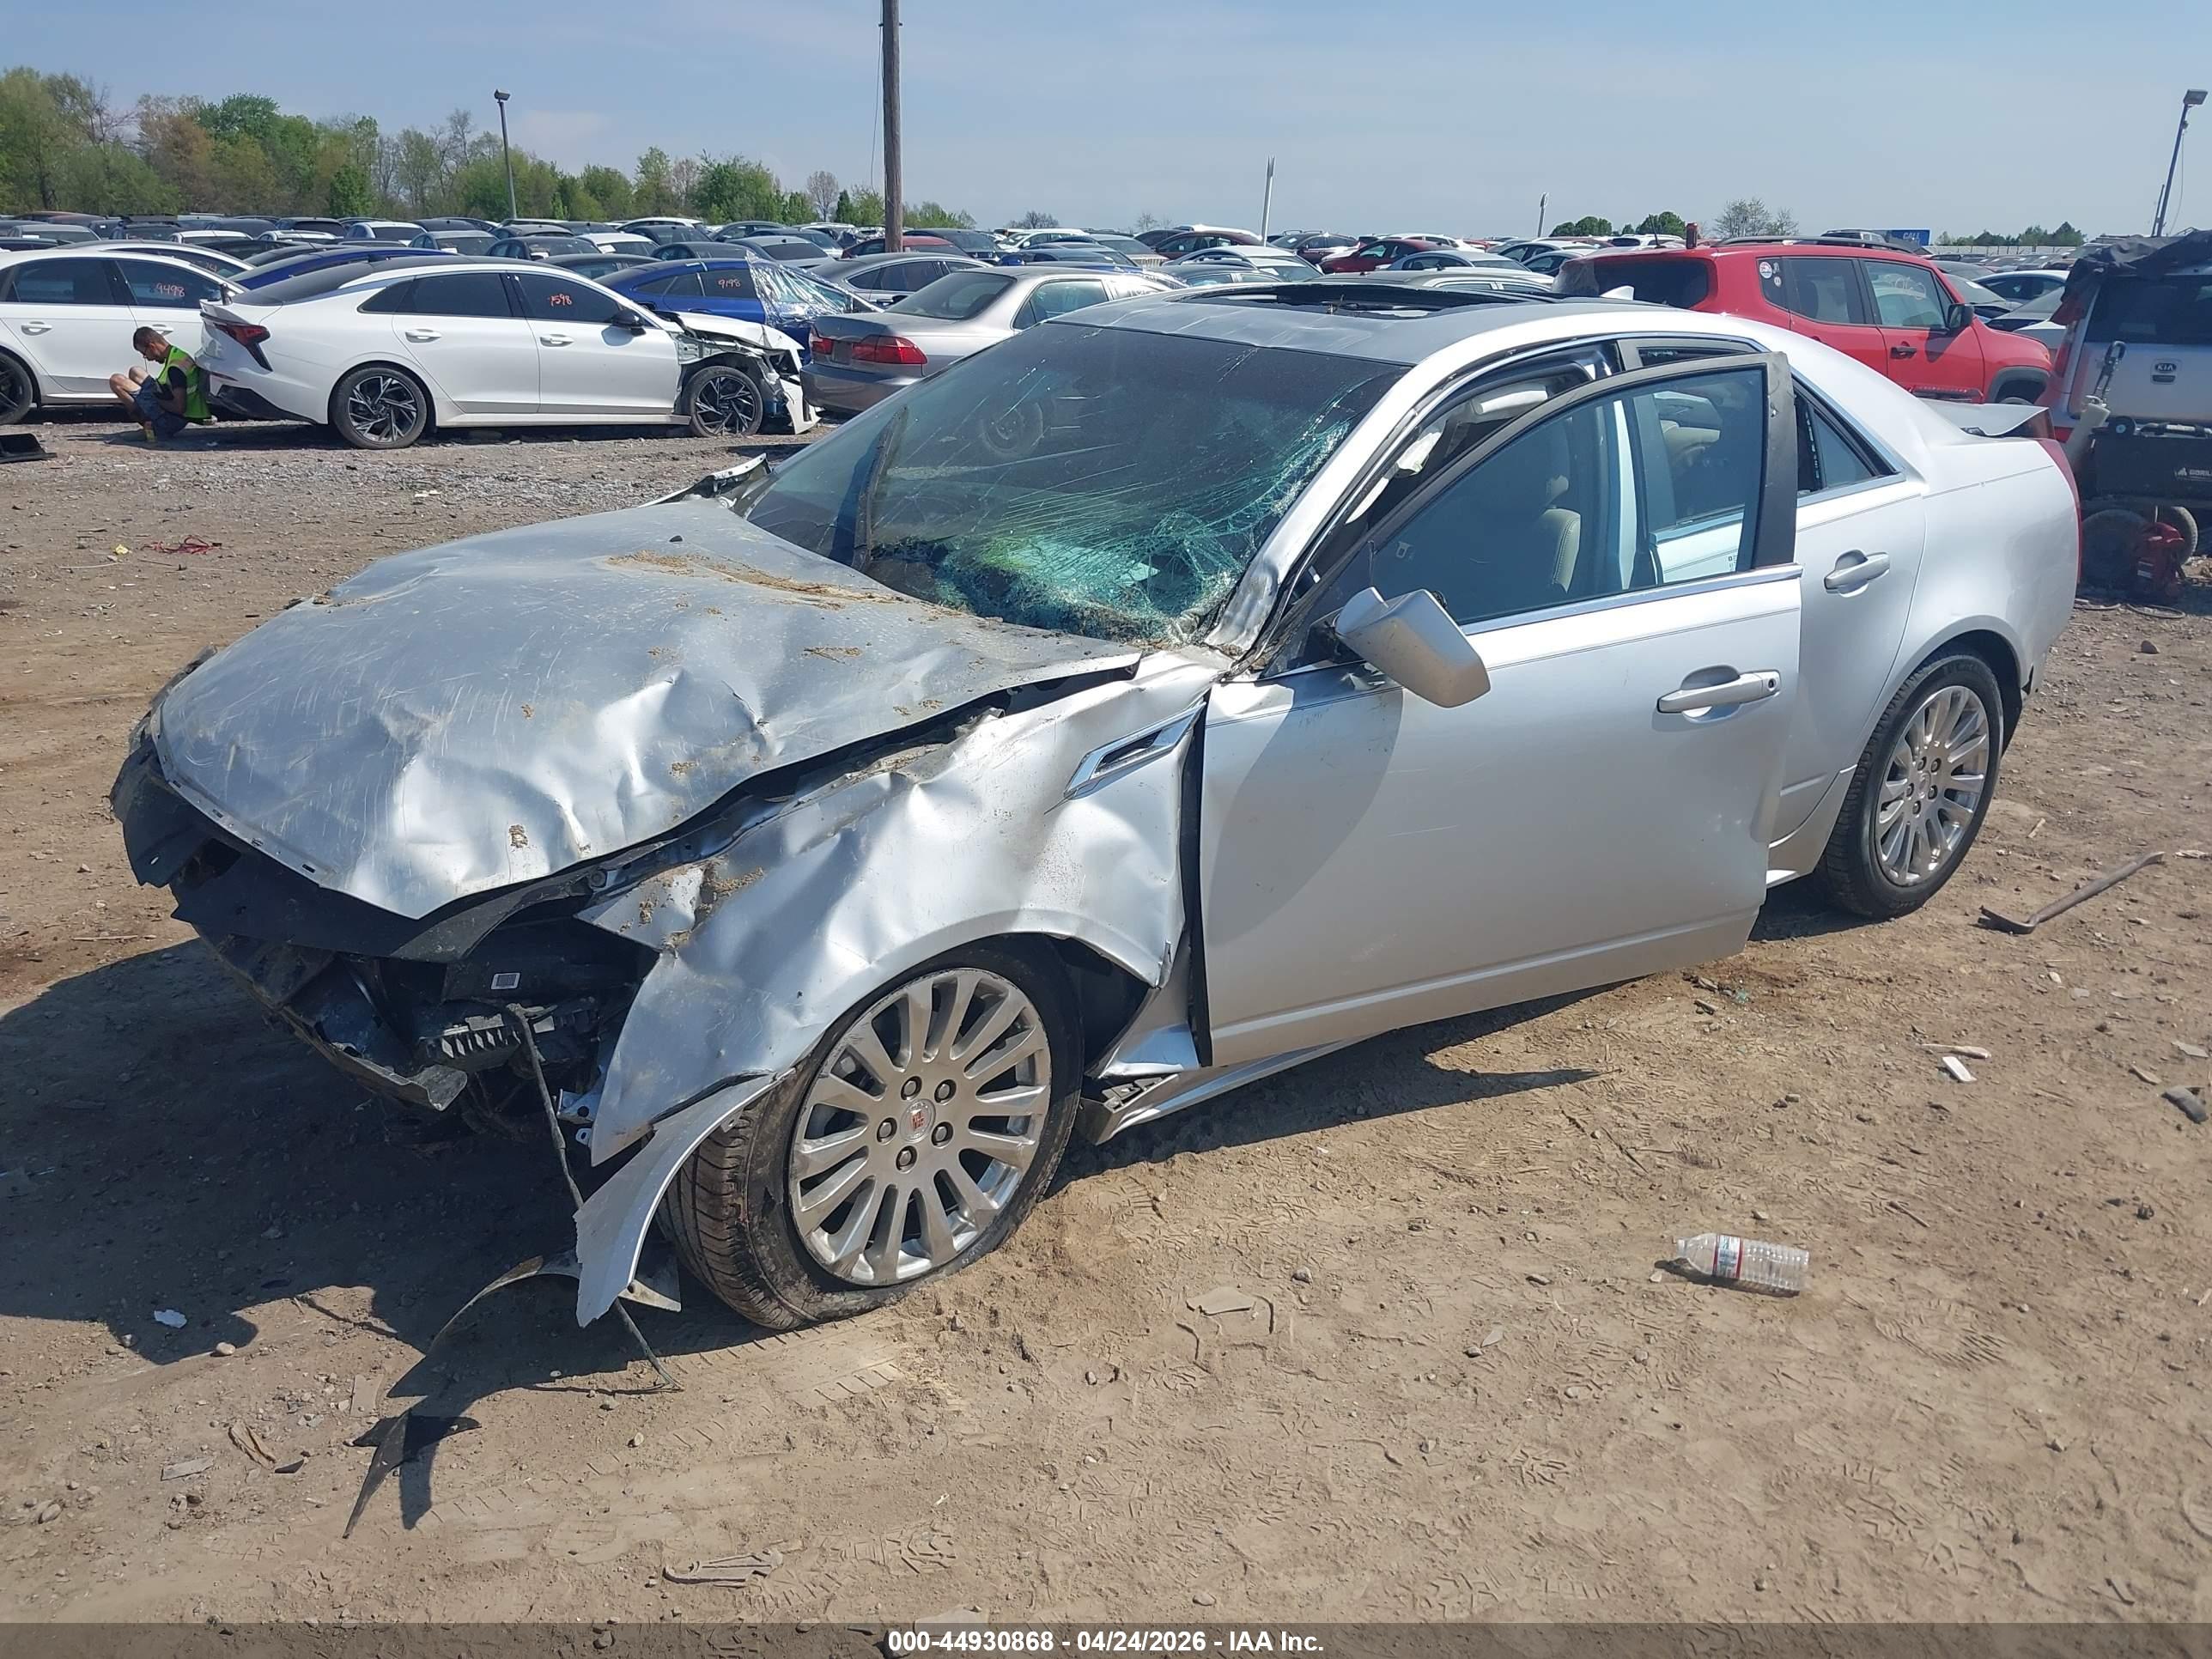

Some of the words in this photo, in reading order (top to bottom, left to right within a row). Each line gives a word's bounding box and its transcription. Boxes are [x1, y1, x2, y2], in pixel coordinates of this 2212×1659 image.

[718, 278, 741, 289] 9198
[156, 283, 185, 297] 9498
[2156, 362, 2175, 371] KIA
